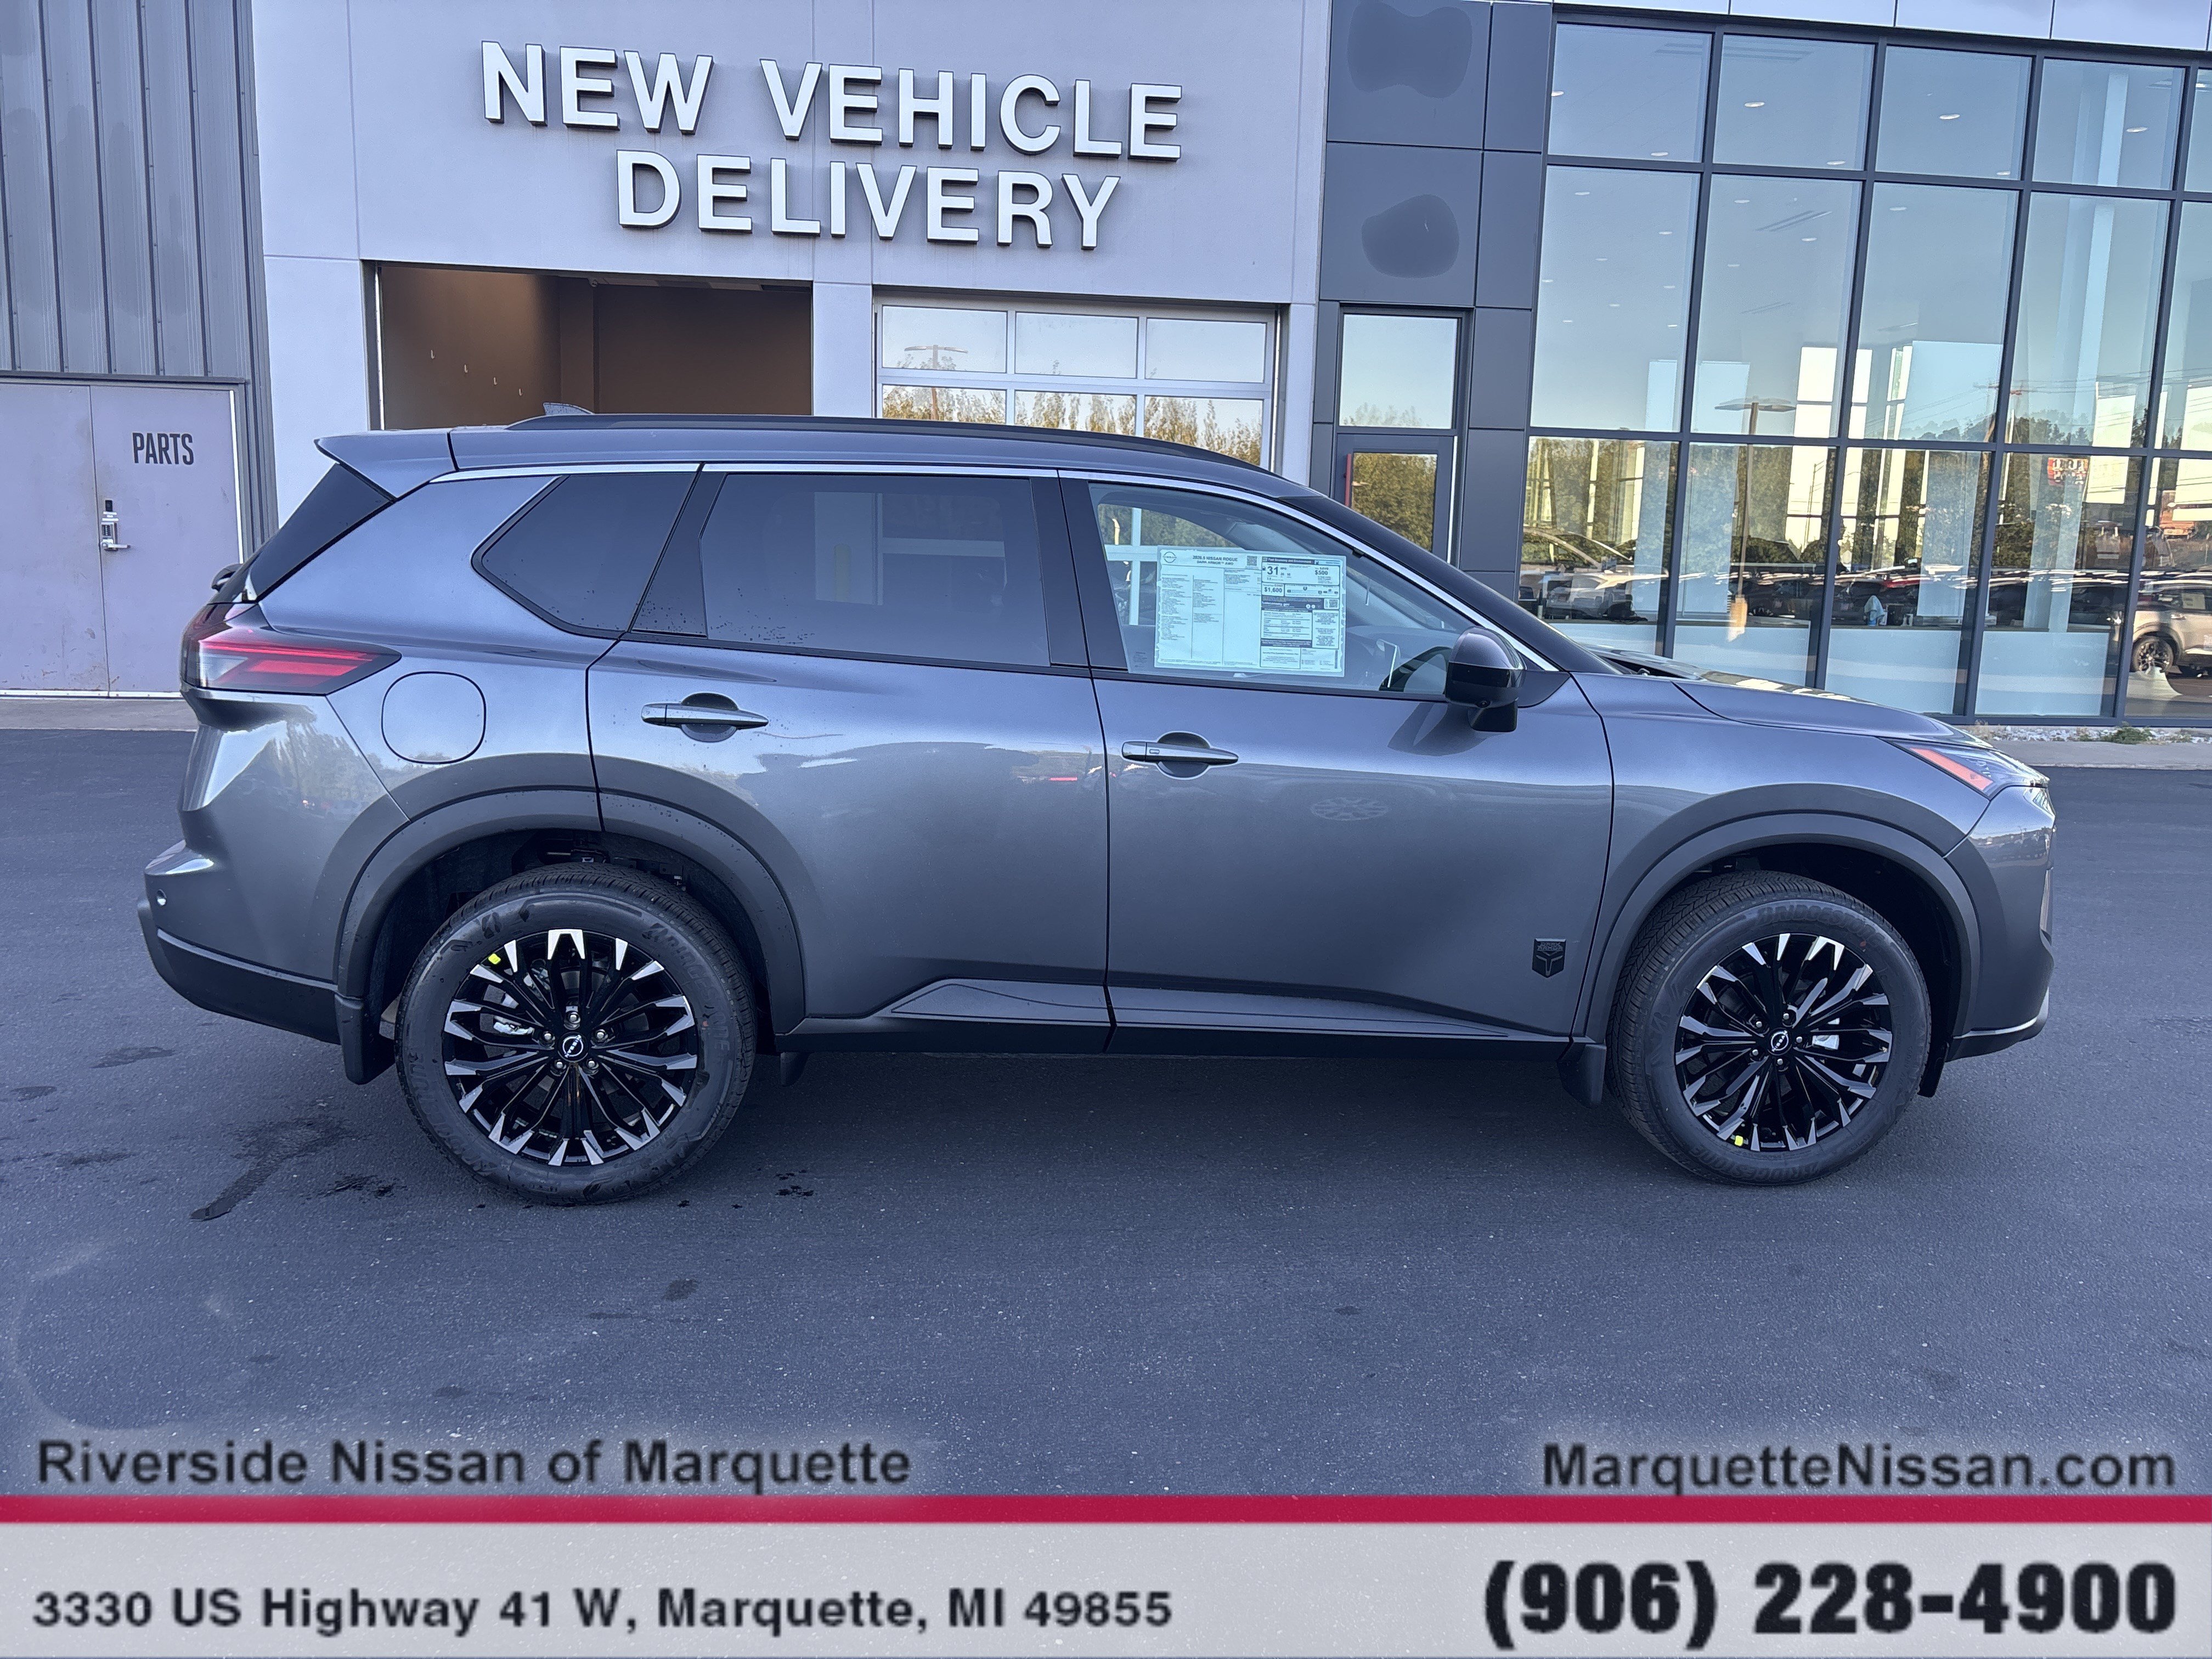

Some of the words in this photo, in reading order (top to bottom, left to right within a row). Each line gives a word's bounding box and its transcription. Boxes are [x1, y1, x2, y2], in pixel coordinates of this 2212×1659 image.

[481, 41, 714, 136] NEW
[759, 59, 1183, 161] VEHICLE
[616, 149, 1122, 250] DELIVERY
[132, 432, 194, 465] PARTS
[1267, 566, 1278, 575] 31
